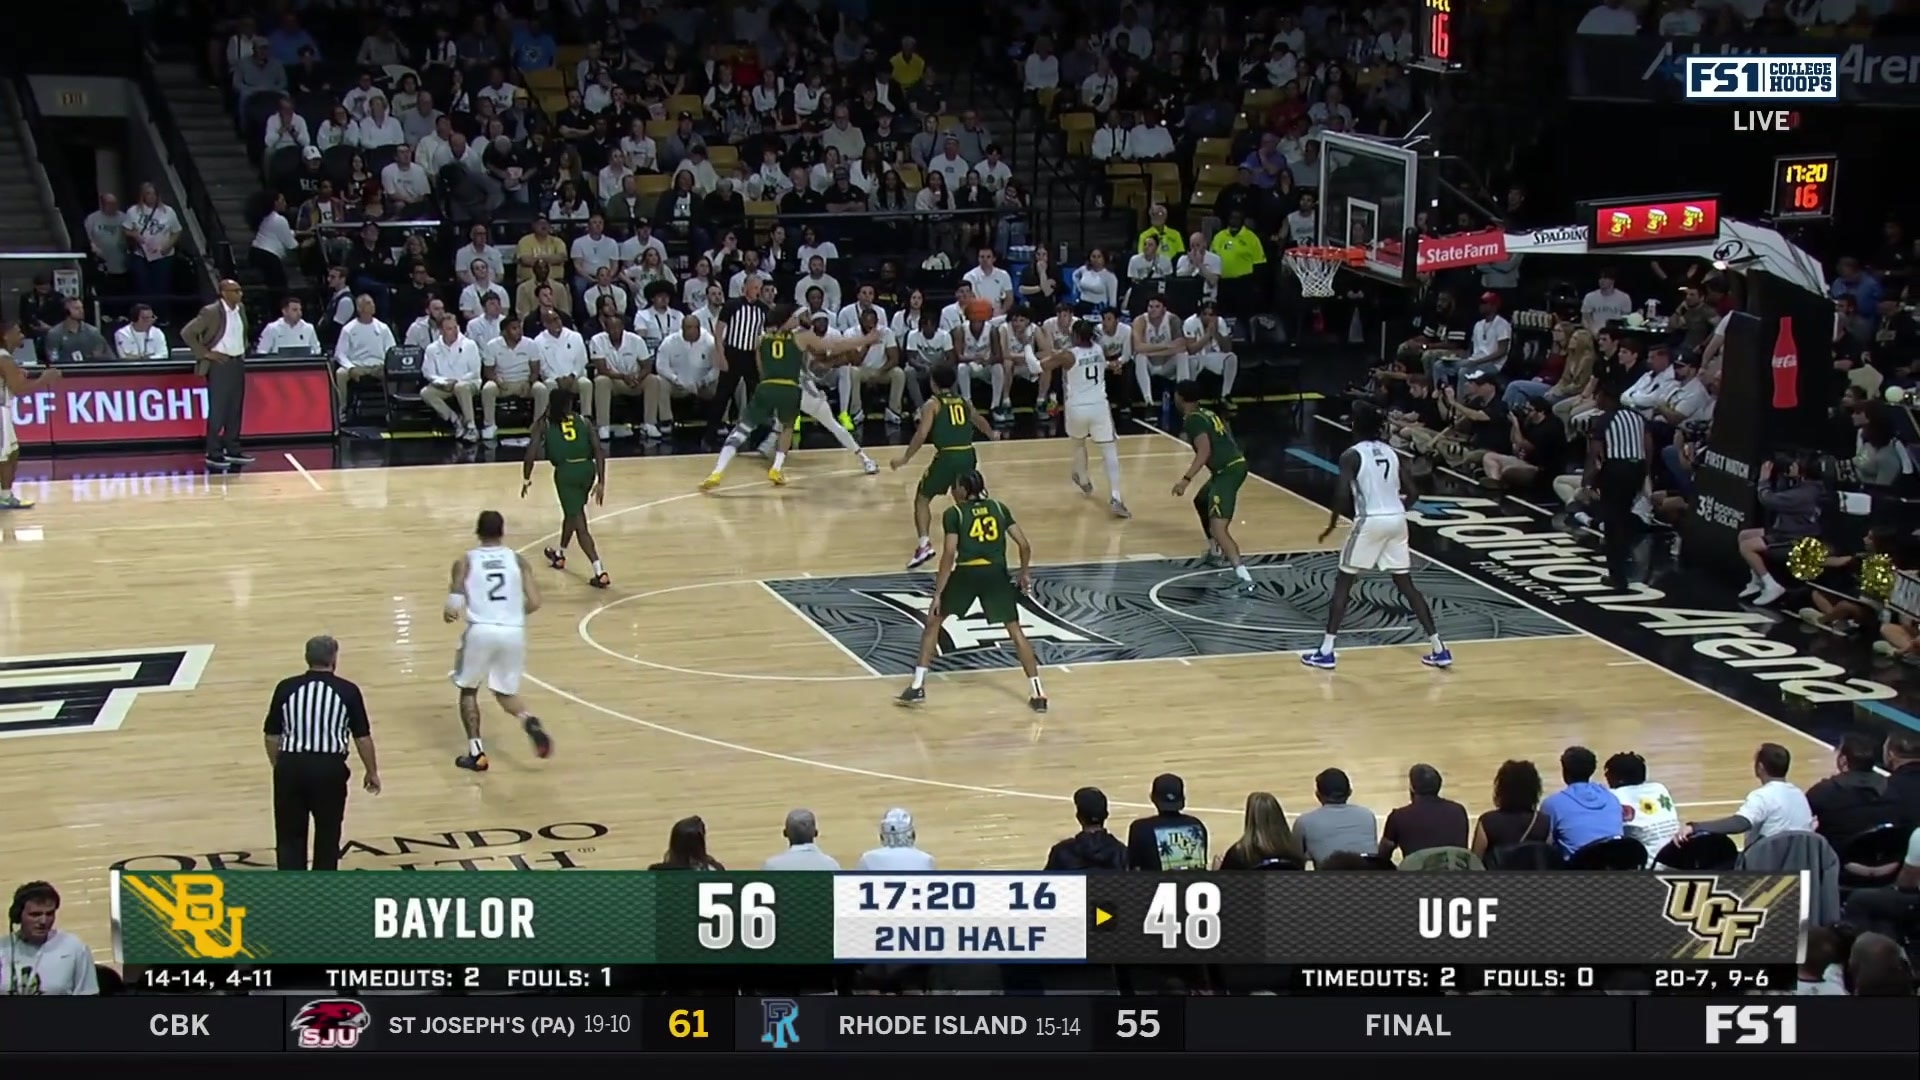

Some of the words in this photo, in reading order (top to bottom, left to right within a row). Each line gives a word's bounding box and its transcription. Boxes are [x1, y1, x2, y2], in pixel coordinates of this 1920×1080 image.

[1431, 13, 1449, 57] 16
[1785, 163, 1828, 183] 17:20
[1794, 184, 1818, 208] 16
[771, 340, 784, 359] 0
[1084, 365, 1099, 386] 4
[948, 403, 966, 426] 10
[561, 421, 577, 442] 5
[1375, 458, 1390, 480] 7
[1704, 449, 1725, 471] FIRST
[969, 516, 998, 542] 43
[486, 572, 507, 601] 2
[1470, 560, 1576, 606] FINANCIAL
[1598, 602, 1898, 704] Arena
[109, 821, 609, 871] ORANDO
